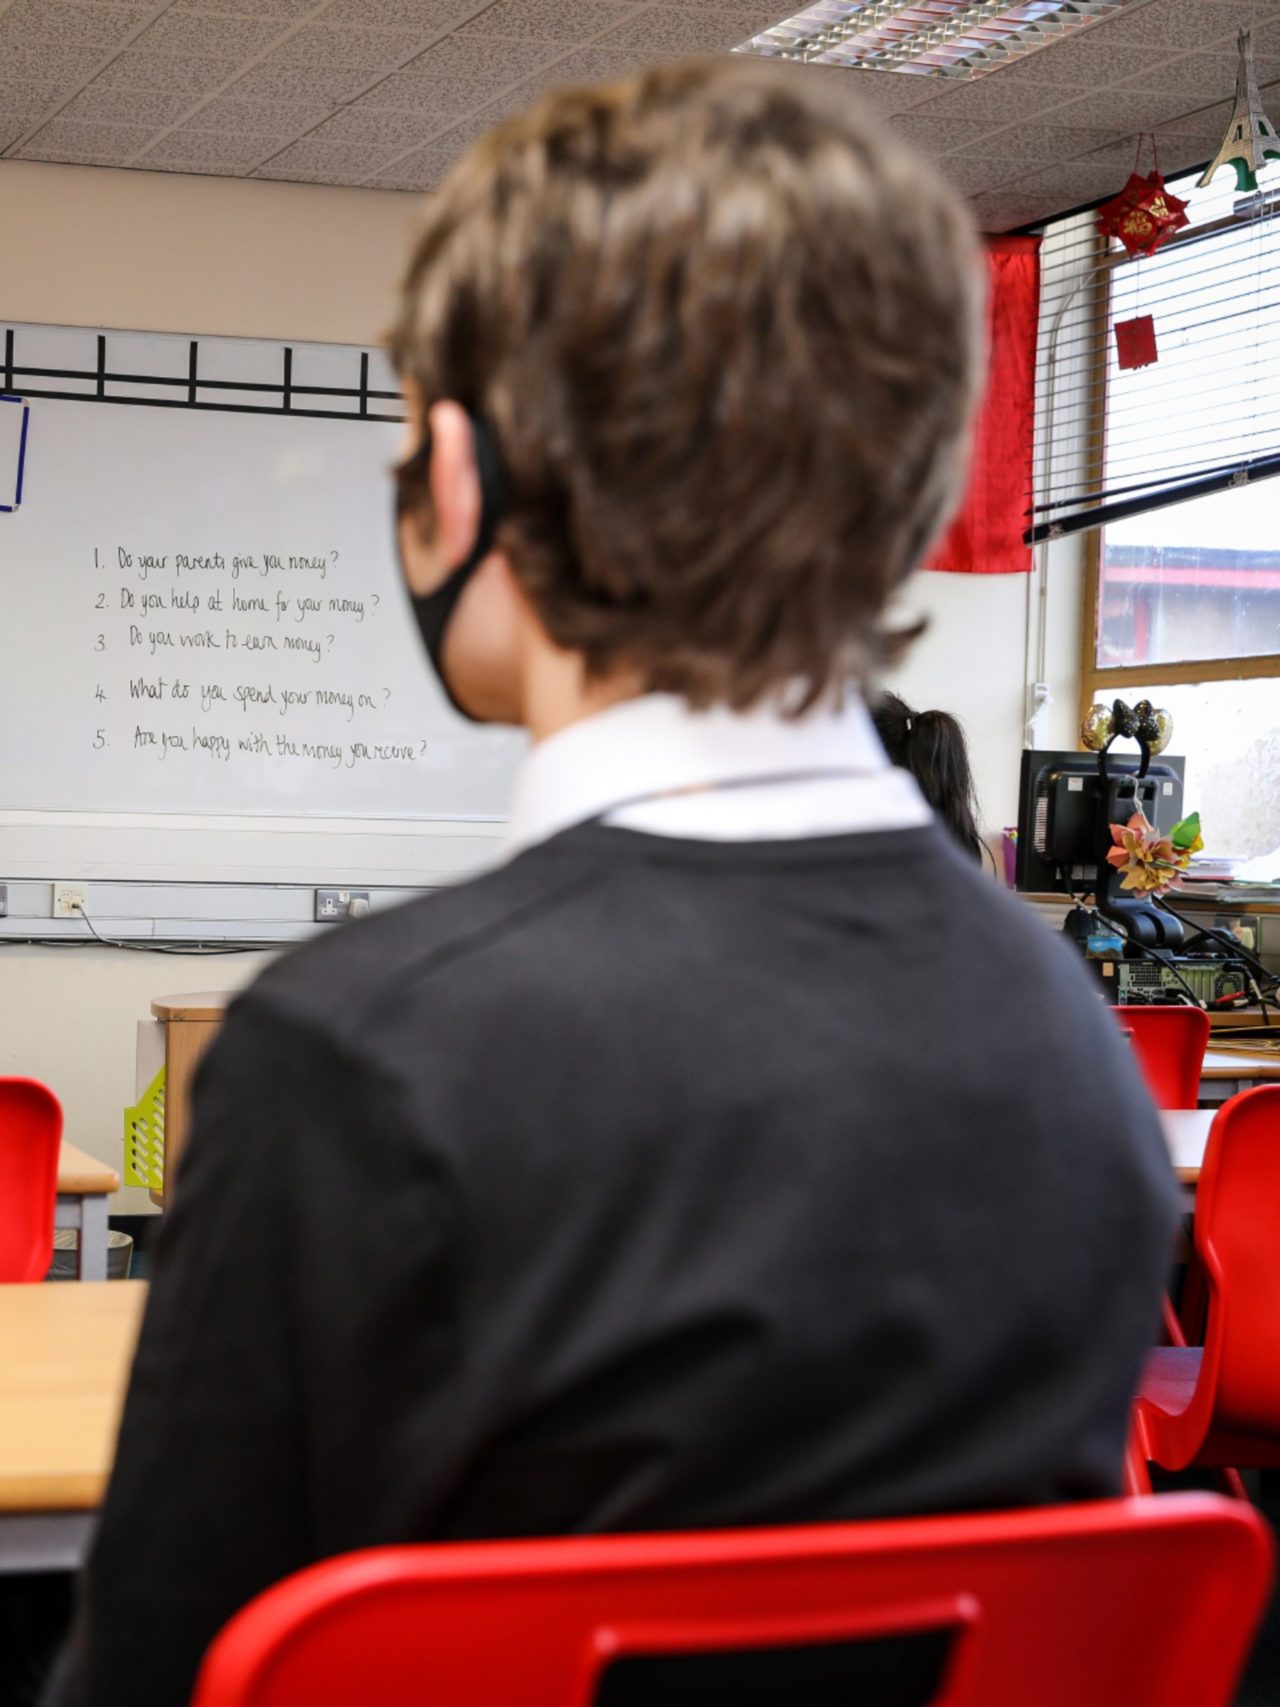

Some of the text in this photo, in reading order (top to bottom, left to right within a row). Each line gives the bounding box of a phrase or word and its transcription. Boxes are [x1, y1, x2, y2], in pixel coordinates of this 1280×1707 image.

[118, 547, 133, 567] Do
[137, 555, 169, 581] your
[176, 552, 225, 577] parents
[232, 553, 260, 579] give
[262, 554, 286, 577] you
[120, 587, 135, 609] Do
[141, 593, 168, 619] you
[171, 588, 200, 614] help
[208, 588, 224, 612] at
[232, 587, 270, 612] home
[275, 590, 291, 622] for
[296, 599, 322, 622] your
[129, 625, 143, 646] Do
[149, 629, 174, 655] you
[180, 630, 220, 648] work
[129, 675, 168, 701] What
[171, 679, 190, 699] do
[201, 686, 227, 713] you
[233, 684, 276, 712] spend
[280, 690, 313, 716] your
[316, 690, 355, 722] money
[134, 725, 157, 748] Are
[161, 732, 188, 760] you
[192, 727, 230, 762] happy
[238, 732, 272, 757] with
[276, 734, 301, 756] the
[301, 743, 342, 770] money
